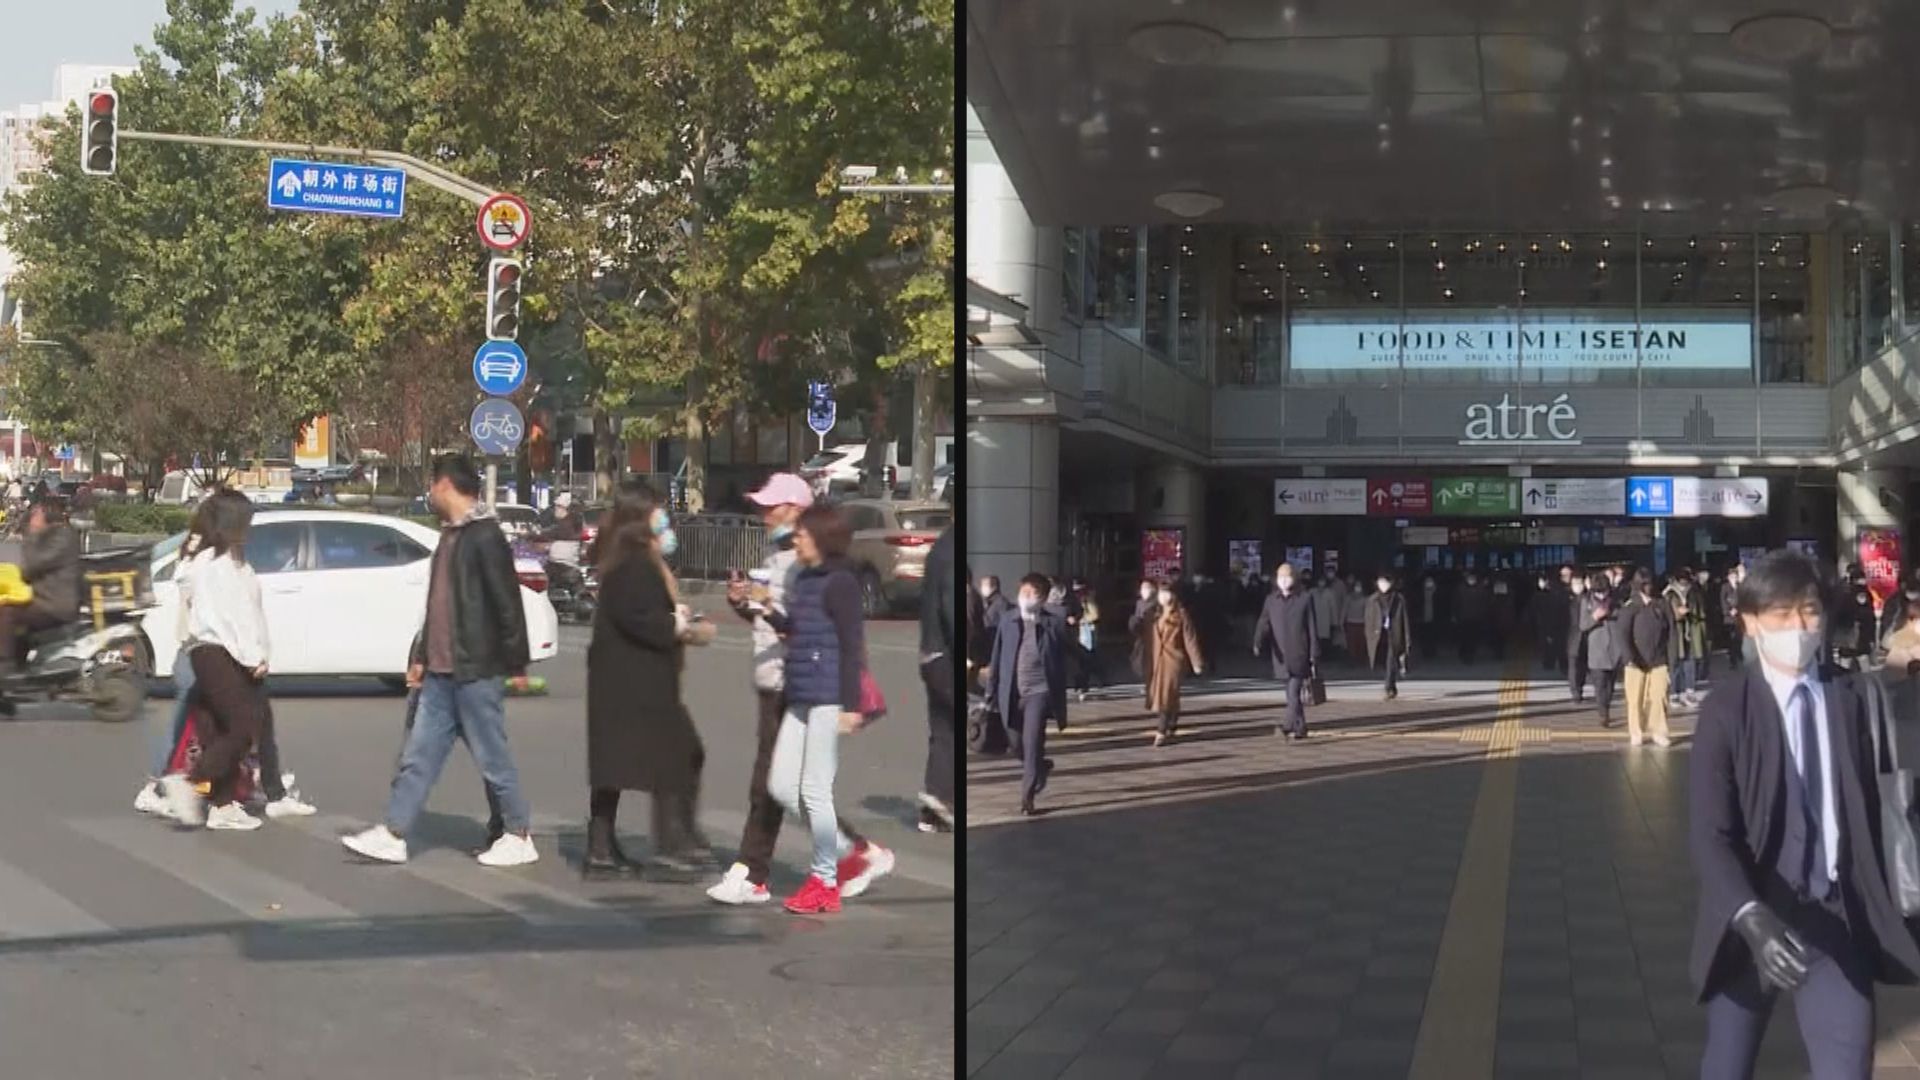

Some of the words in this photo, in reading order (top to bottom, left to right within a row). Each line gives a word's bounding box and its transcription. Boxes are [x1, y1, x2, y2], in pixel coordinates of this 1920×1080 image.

[303, 168, 398, 194] 朝外市场街
[303, 192, 382, 208] CHAOWAISHICHANG
[1358, 331, 1445, 350] FOOD
[1455, 331, 1474, 349] &
[1481, 331, 1571, 349] TIME
[1581, 330, 1686, 349] ISETAN
[1465, 393, 1576, 439] atré
